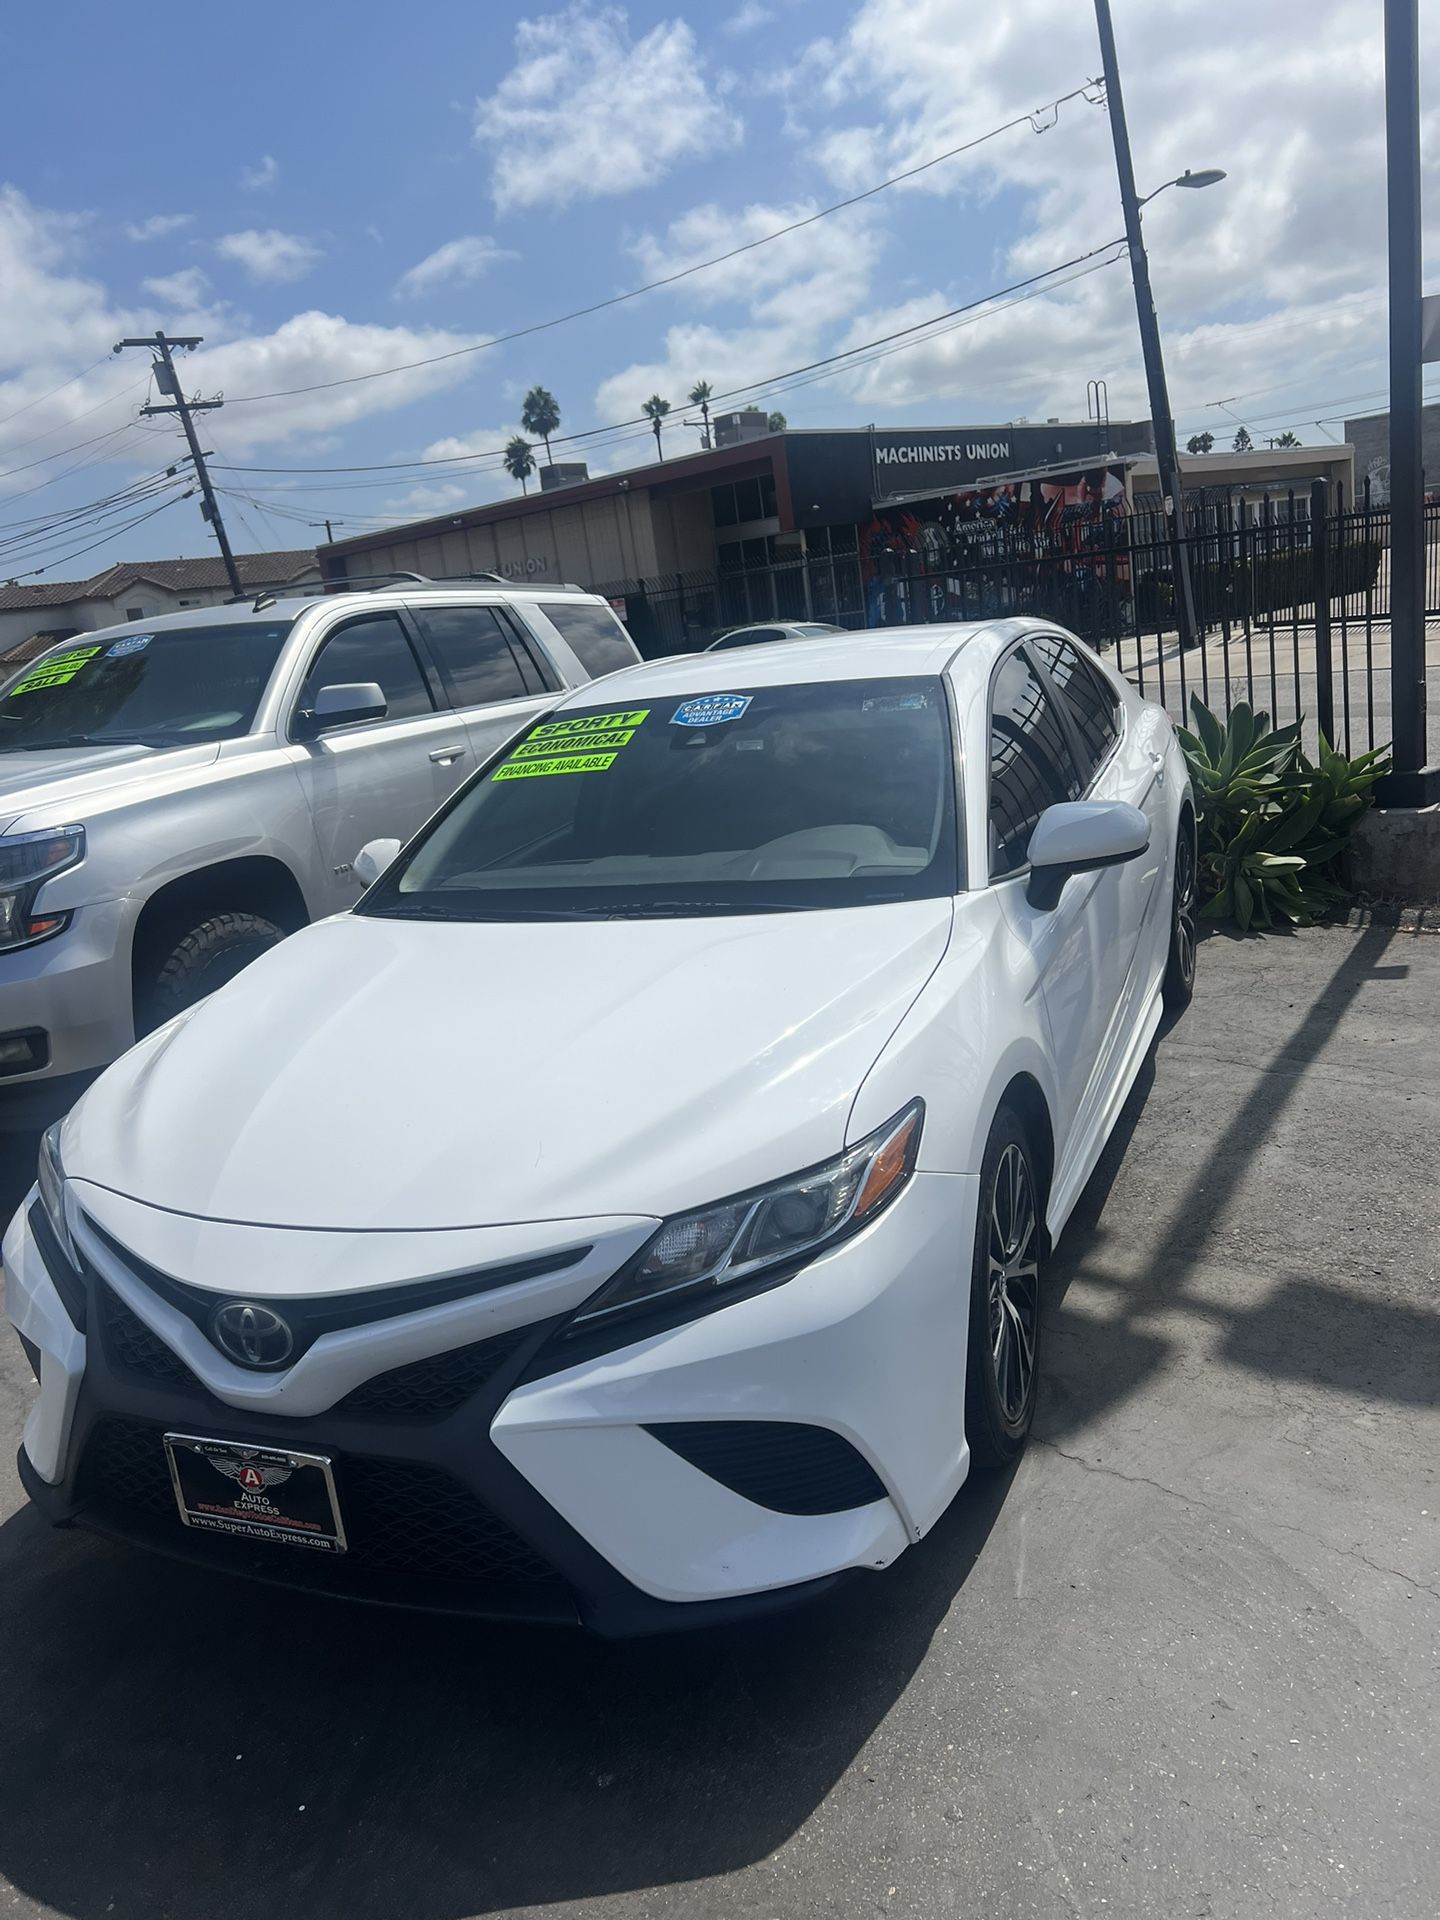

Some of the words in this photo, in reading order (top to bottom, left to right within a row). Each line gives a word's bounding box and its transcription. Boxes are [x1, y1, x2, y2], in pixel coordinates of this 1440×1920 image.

[876, 445, 961, 464] MACHINISTS
[966, 442, 1010, 460] UNION
[502, 556, 547, 578] UNION
[23, 676, 62, 690] SALE
[682, 708, 735, 718] ADVANTAGE
[687, 715, 723, 723] DEALER
[534, 712, 641, 738] SPORTY
[519, 731, 629, 756] ECONOMICAL
[497, 761, 552, 778] FINANCING
[552, 756, 611, 772] AVAILABLE
[245, 1469, 260, 1485] A
[233, 1500, 280, 1516] EXPRESS
[241, 1492, 270, 1506] AUTO
[191, 1516, 331, 1549] www.SuperAutoExpress.com
